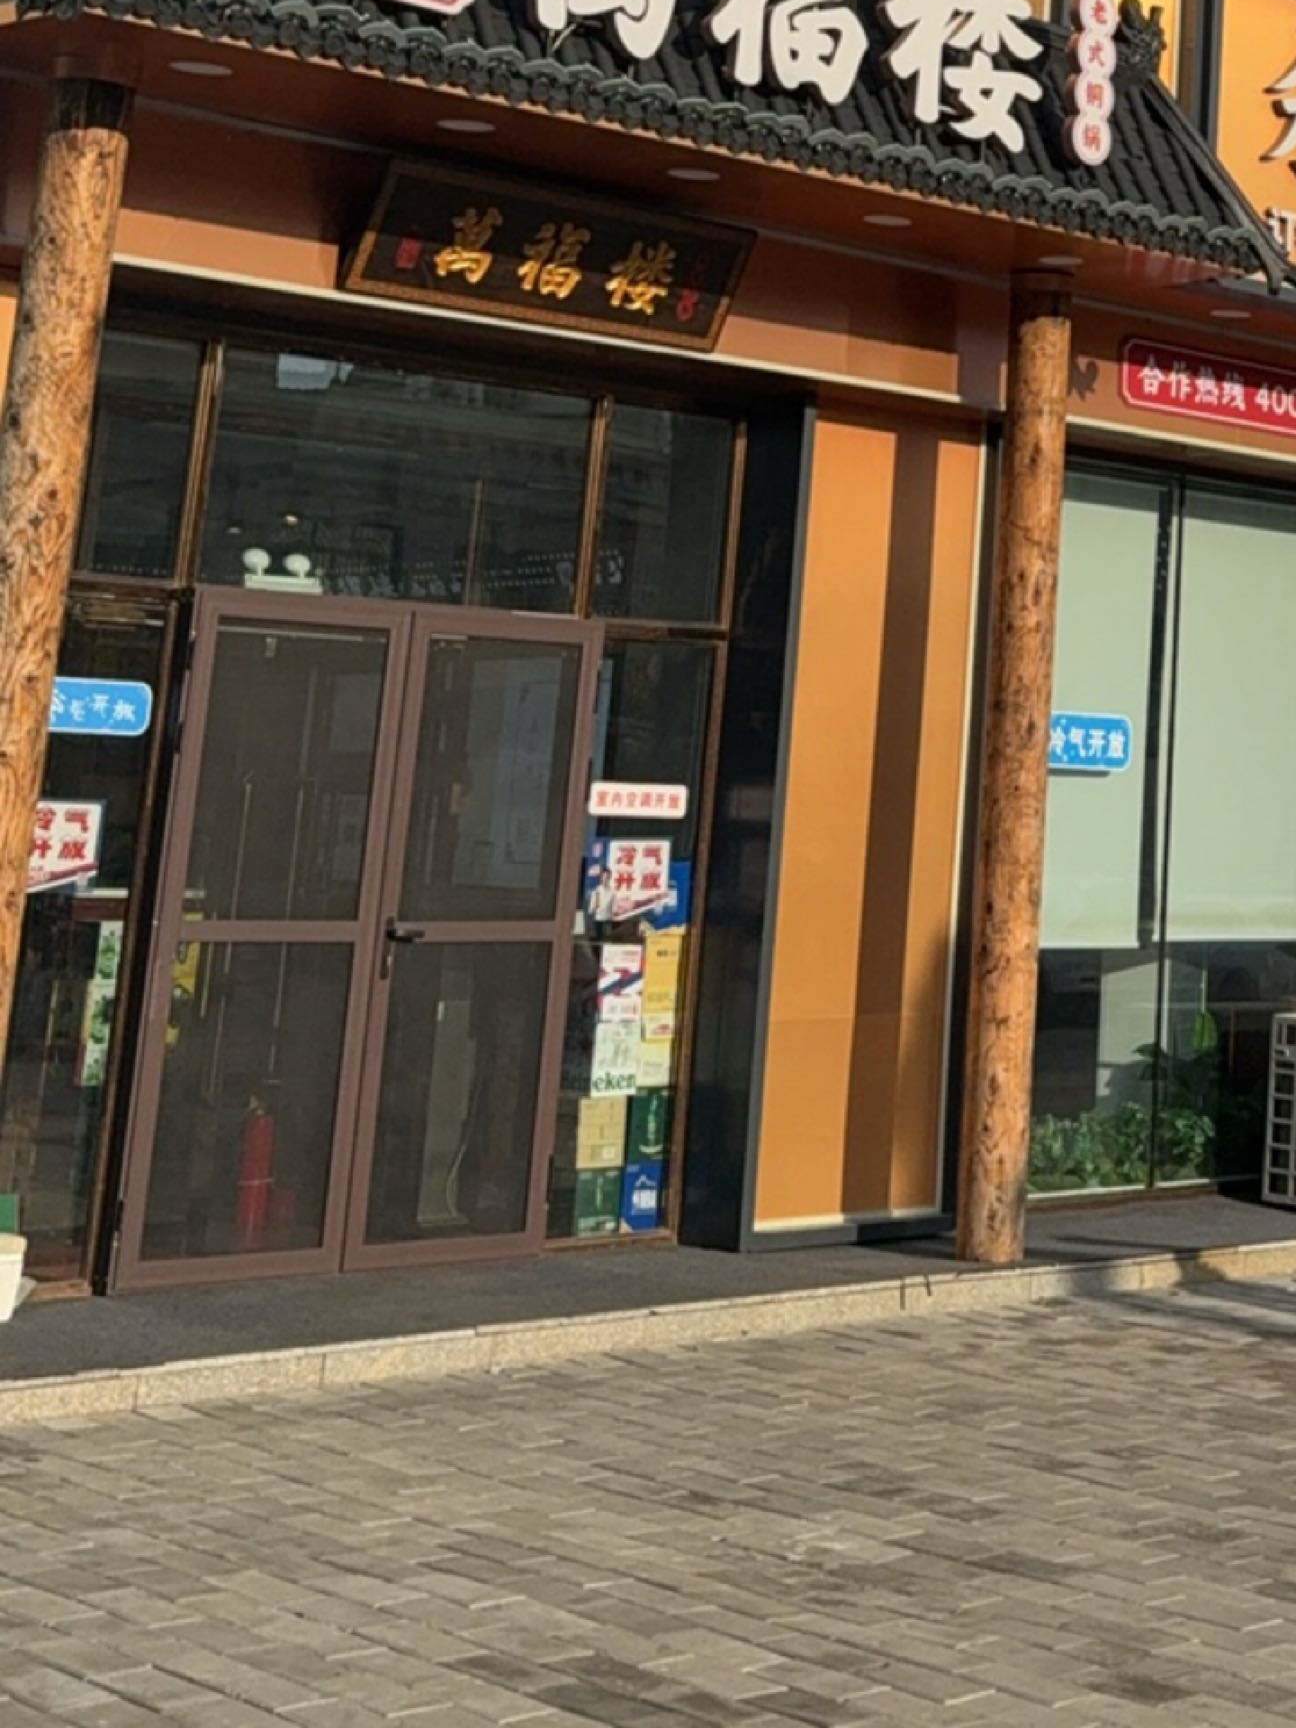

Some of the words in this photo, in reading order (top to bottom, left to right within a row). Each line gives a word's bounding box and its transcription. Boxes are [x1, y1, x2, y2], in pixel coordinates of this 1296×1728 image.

[434, 207, 675, 315] 萬福楼
[1138, 356, 1246, 411] 合作热线
